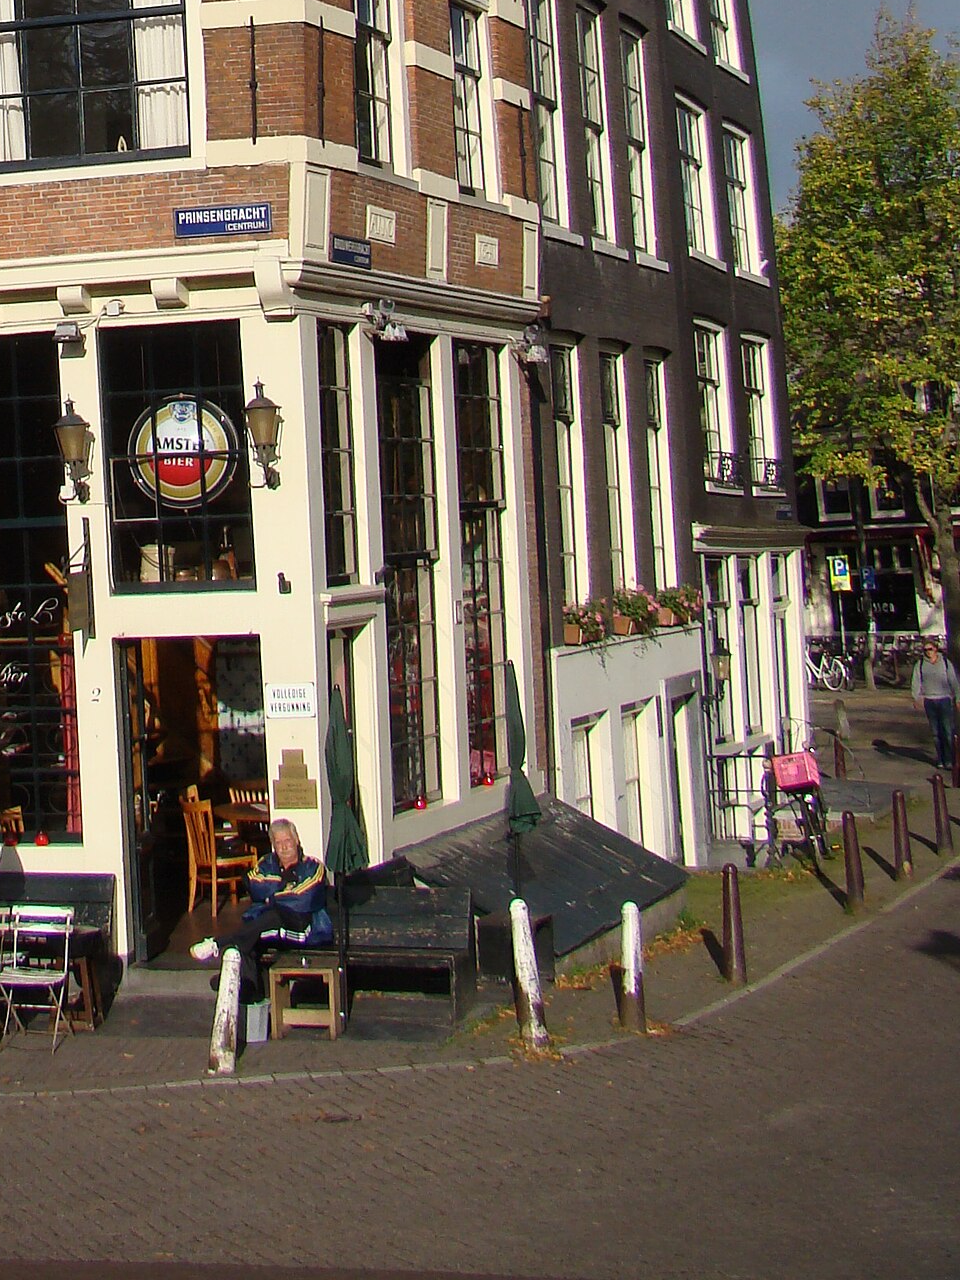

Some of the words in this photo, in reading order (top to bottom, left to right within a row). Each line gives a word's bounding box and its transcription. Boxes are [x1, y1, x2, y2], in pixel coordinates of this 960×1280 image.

[178, 207, 267, 224] PRINSENGRACHT
[163, 456, 194, 467] BIER
[91, 687, 101, 703] 2
[269, 702, 311, 713] VERGUNNING
